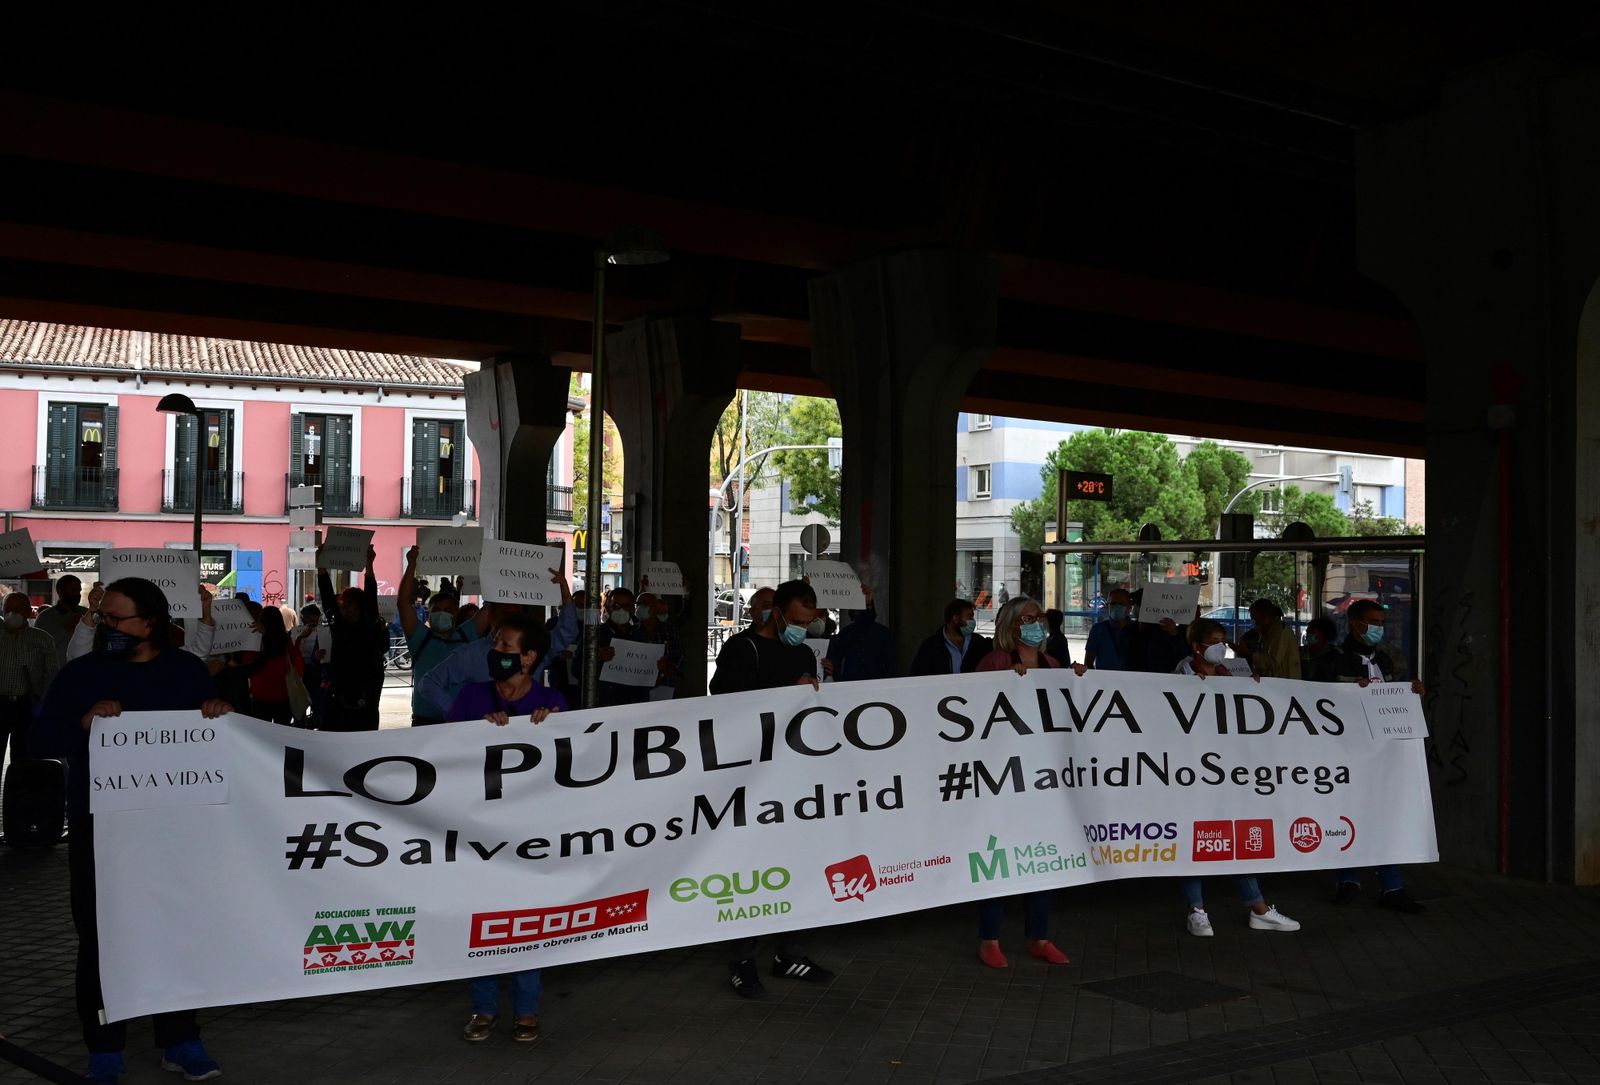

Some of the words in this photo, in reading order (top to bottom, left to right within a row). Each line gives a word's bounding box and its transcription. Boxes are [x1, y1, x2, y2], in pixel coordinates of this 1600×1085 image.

[438, 538, 464, 546] RENTA
[112, 553, 190, 564] SOLIDARIDAD
[421, 555, 477, 563] GARANTIZADA
[499, 547, 544, 559] REFUERZO
[200, 562, 224, 570] ATURE
[500, 569, 540, 580] CENTROS
[150, 579, 177, 588] RIOS
[498, 589, 510, 598] DE
[514, 590, 544, 600] SALUD
[219, 622, 251, 631] ATIVOS
[212, 640, 242, 650] GUROS
[1378, 706, 1409, 715] CENTROS
[101, 731, 128, 748] LO
[134, 727, 216, 746] PÚBLICO
[284, 745, 437, 806] LO
[484, 701, 907, 801] PÚBLICO
[936, 688, 1143, 742] SALVA
[1162, 691, 1345, 737] VIDAS
[93, 773, 158, 791] SALVA
[165, 769, 225, 787] VIDAS
[285, 774, 904, 871] #SalvemosMadrid
[938, 751, 1351, 802] #MadridNoSegrega
[1083, 821, 1178, 843] PODEMOS
[1197, 829, 1222, 839] Madrid
[1293, 822, 1317, 837] UGT
[1325, 828, 1347, 837] Madrid
[1013, 842, 1058, 860] Más
[1196, 839, 1231, 852] PSOE
[878, 859, 922, 875] izquierda
[924, 855, 951, 868] unida
[1016, 852, 1087, 878] Madrid
[879, 872, 914, 887] Madrid
[314, 908, 371, 919] ASOCIACIONES
[376, 906, 416, 916] VECINALES
[717, 901, 792, 923] MADRID
[480, 906, 598, 941] CCOO
[467, 943, 539, 958] comisiones
[543, 934, 587, 949] obreras
[590, 930, 604, 940] de
[607, 923, 649, 937] Madrid
[348, 962, 383, 971] REGIONAL
[384, 959, 413, 968] MADRID
